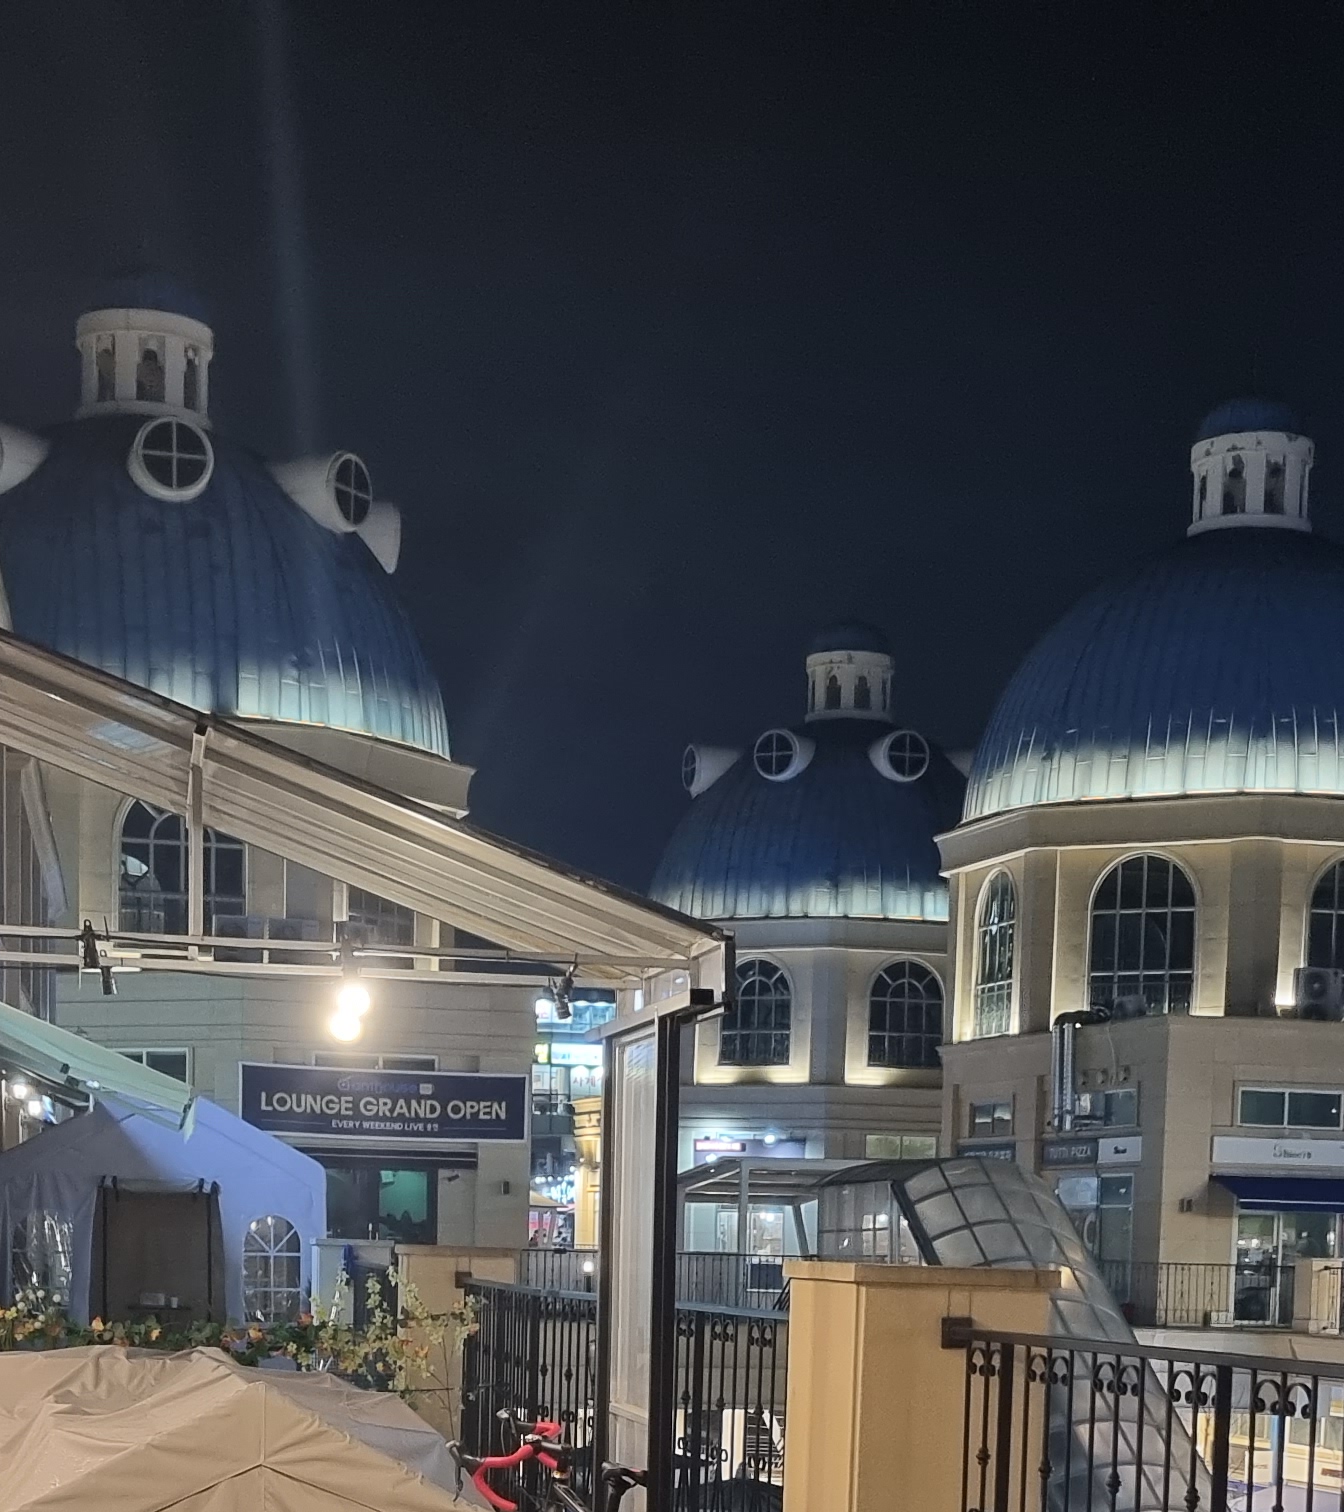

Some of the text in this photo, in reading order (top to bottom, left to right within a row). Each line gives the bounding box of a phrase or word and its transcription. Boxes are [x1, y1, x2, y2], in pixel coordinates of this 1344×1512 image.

[260, 1092, 506, 1120] LOUNGE GRAND OPEN
[331, 1119, 360, 1129] EVERY
[362, 1121, 403, 1130] WEEKEND
[404, 1122, 425, 1132] LIVE
